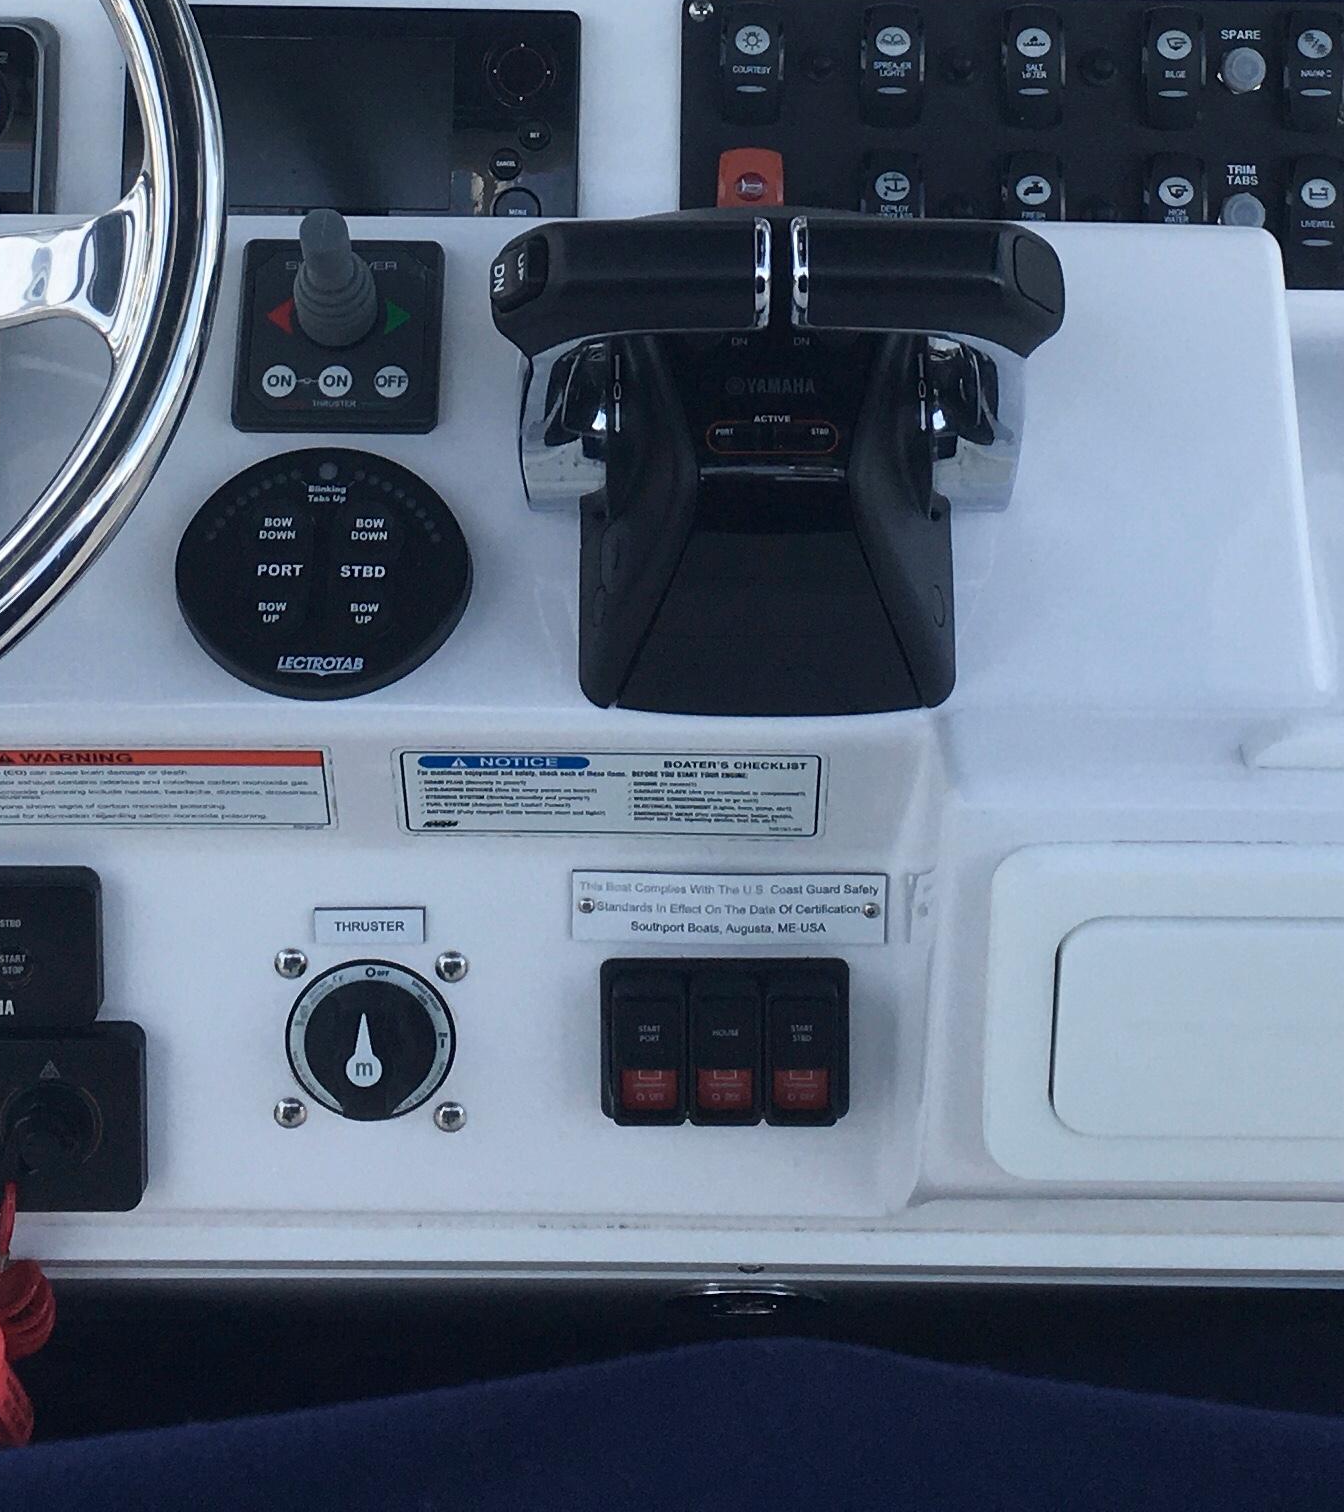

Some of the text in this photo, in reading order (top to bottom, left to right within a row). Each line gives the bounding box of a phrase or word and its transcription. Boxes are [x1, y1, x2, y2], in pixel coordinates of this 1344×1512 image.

[1221, 30, 1261, 40] SPARE
[1227, 165, 1256, 175] TRIM
[1226, 175, 1258, 185] TABS
[267, 375, 292, 387] ON
[323, 375, 348, 387] ON
[375, 375, 407, 388] OFF
[747, 378, 815, 394] YAMAHA
[754, 415, 791, 423] ACTIVE
[264, 517, 293, 527] BOW
[356, 519, 385, 528] BOW
[259, 530, 296, 540] DOWN
[351, 531, 388, 540] DOWN
[257, 564, 304, 576] PORT
[340, 565, 386, 578] STBD
[258, 602, 287, 612] BOW
[350, 603, 379, 613] BOW
[262, 614, 280, 623] UP
[355, 615, 372, 624] UP
[277, 656, 364, 670] LECTROTAB
[20, 753, 134, 763] WARNING
[480, 757, 558, 767] NOTICE
[663, 761, 808, 770] BOATER'S CHECKLIST
[579, 882, 604, 892] This
[606, 882, 632, 893] Boat
[634, 883, 687, 896] Complies
[690, 884, 715, 895] With
[719, 884, 740, 895] The
[770, 885, 803, 895] Coast
[806, 885, 841, 895] Guard
[843, 884, 879, 897] Safety
[597, 902, 861, 916] Standards In Effect On The Date Of Certification
[0, 919, 22, 928] STBD
[334, 921, 405, 932] THRUSTER
[630, 921, 685, 934] Southport
[687, 922, 722, 935] Boats,
[725, 922, 774, 936] Augusta,
[0, 954, 27, 964] START
[2, 966, 25, 975] STOP
